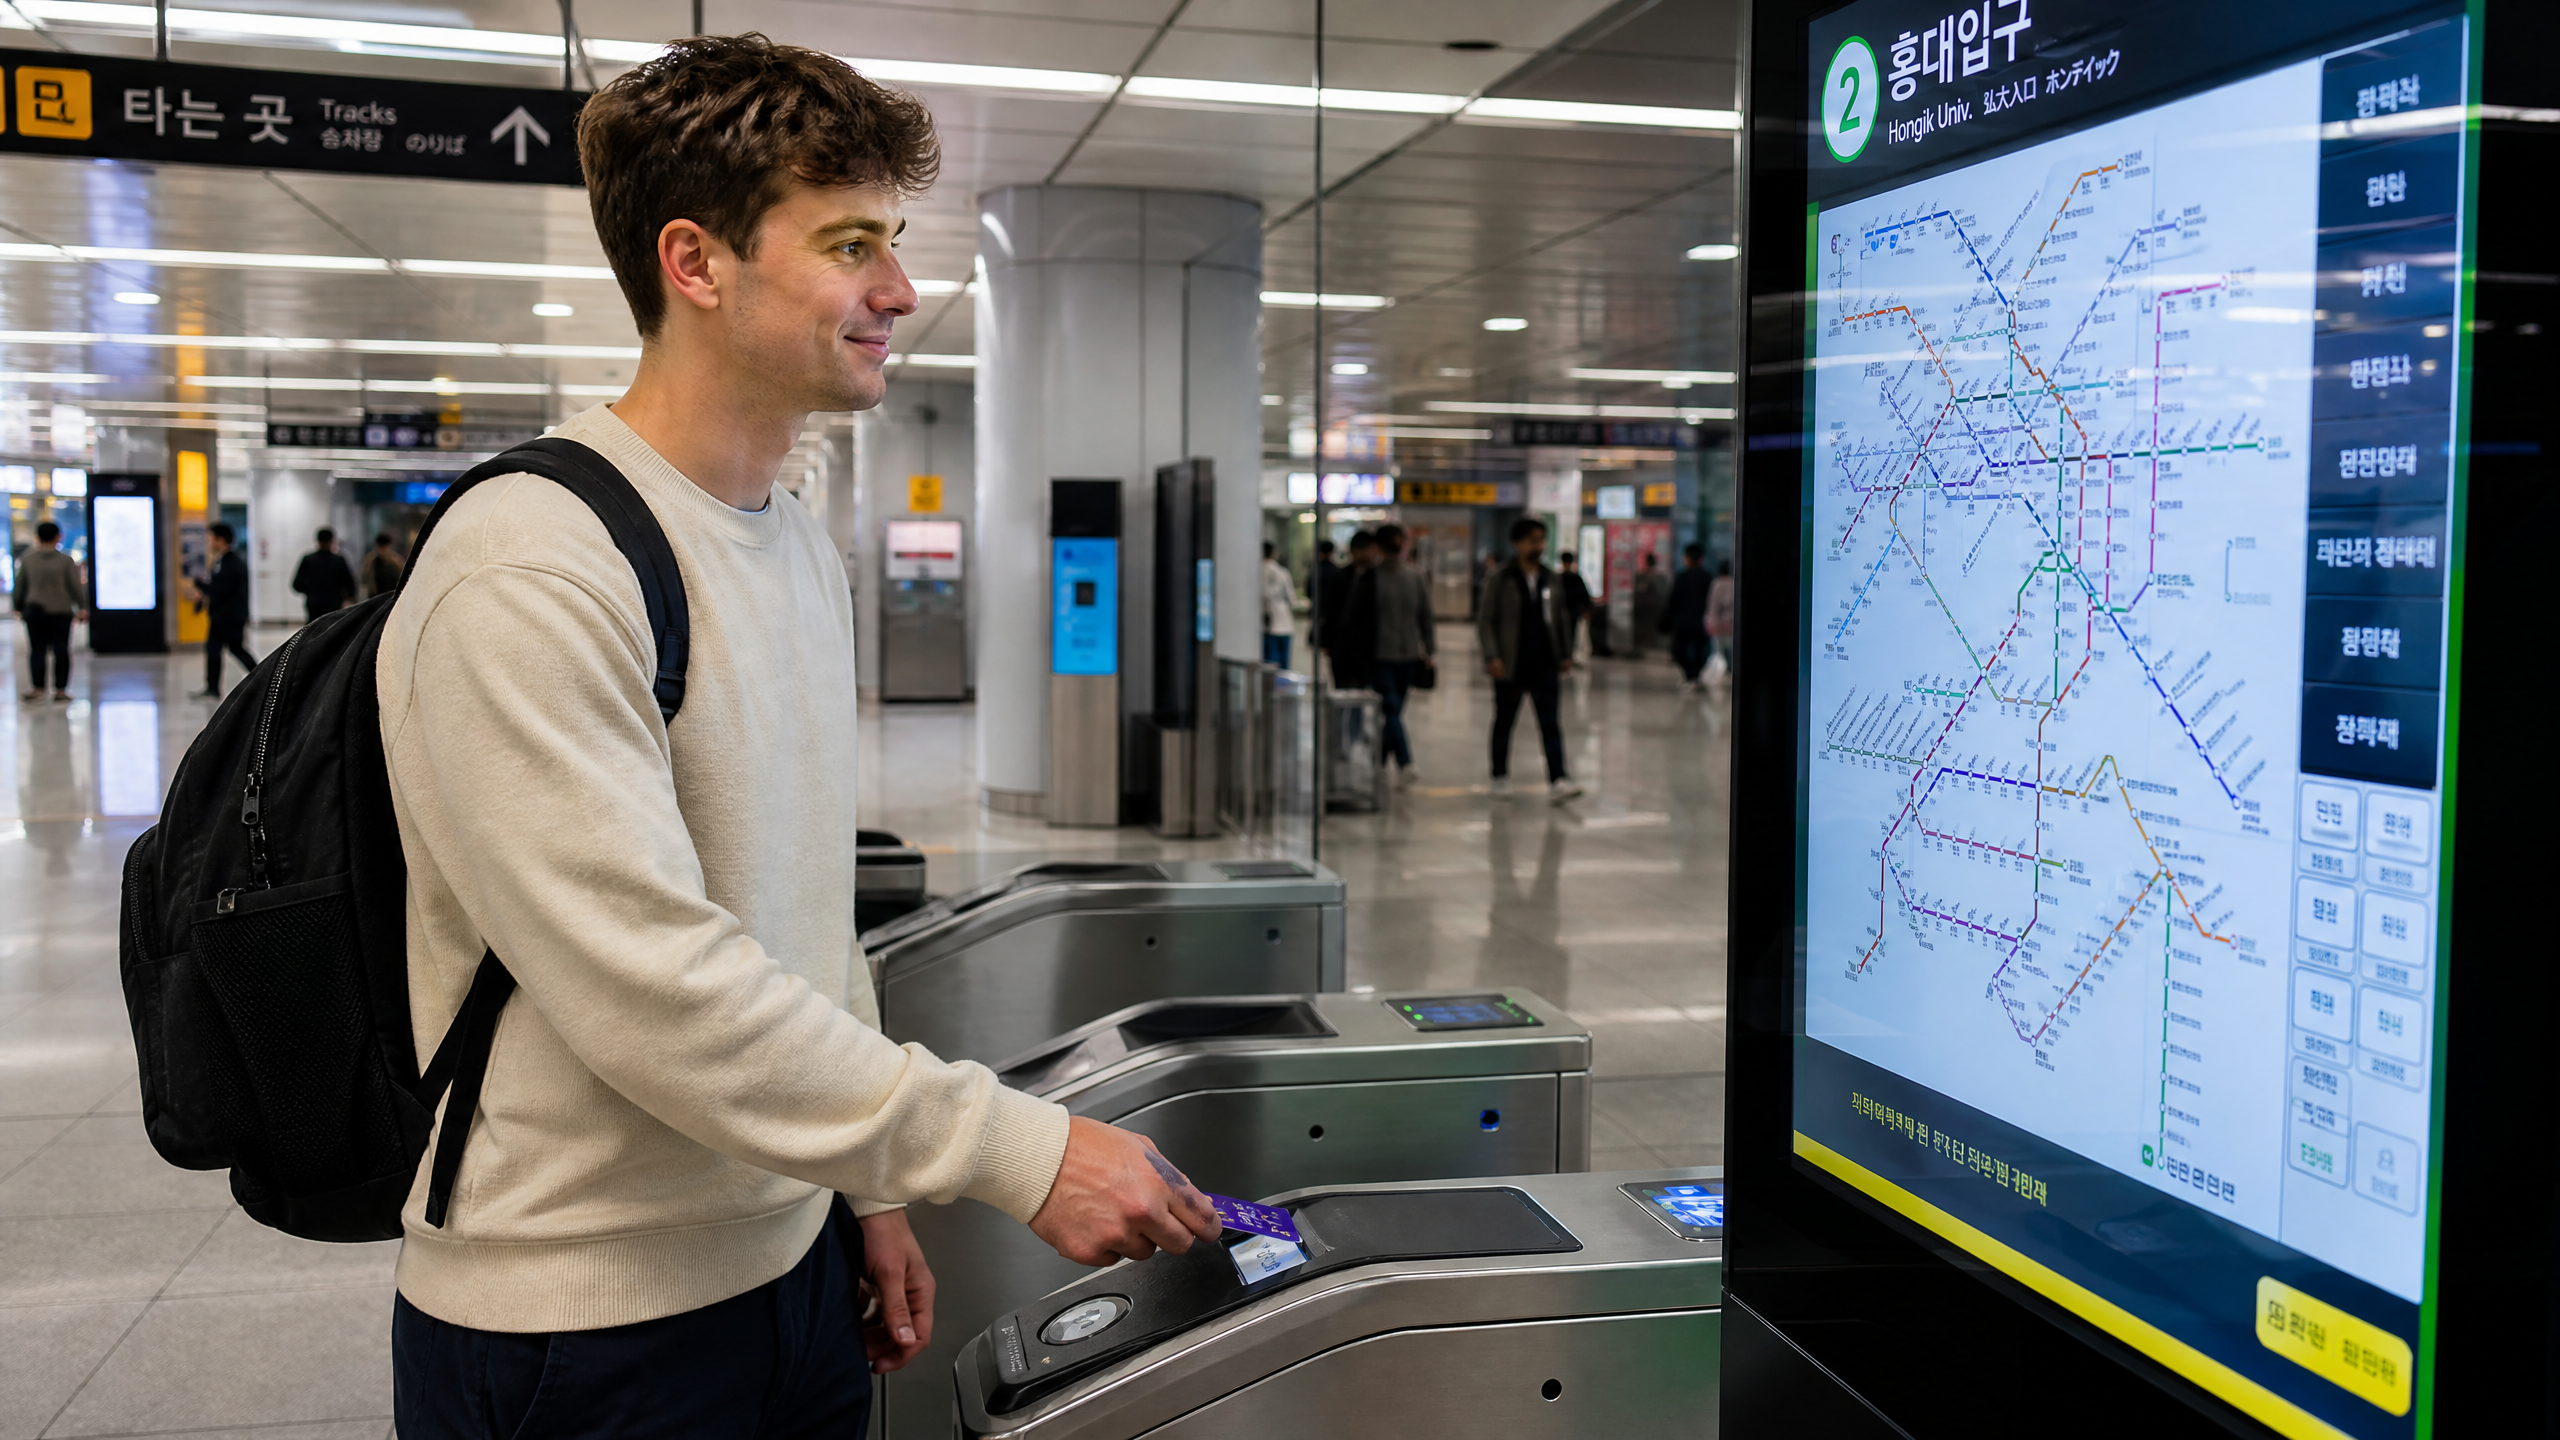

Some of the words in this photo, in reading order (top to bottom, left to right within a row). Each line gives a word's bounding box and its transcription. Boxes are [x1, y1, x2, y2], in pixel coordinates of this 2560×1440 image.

[1888, 0, 2032, 102] 홍대입구
[123, 86, 225, 140] 타는
[243, 94, 293, 144] 곳
[317, 98, 398, 125] Tracks
[1839, 66, 1860, 134] 2
[1888, 108, 1934, 145] Hongik
[1937, 98, 1973, 129] Univ.
[1983, 75, 2037, 116] 弘大入口
[405, 133, 468, 156] のりば
